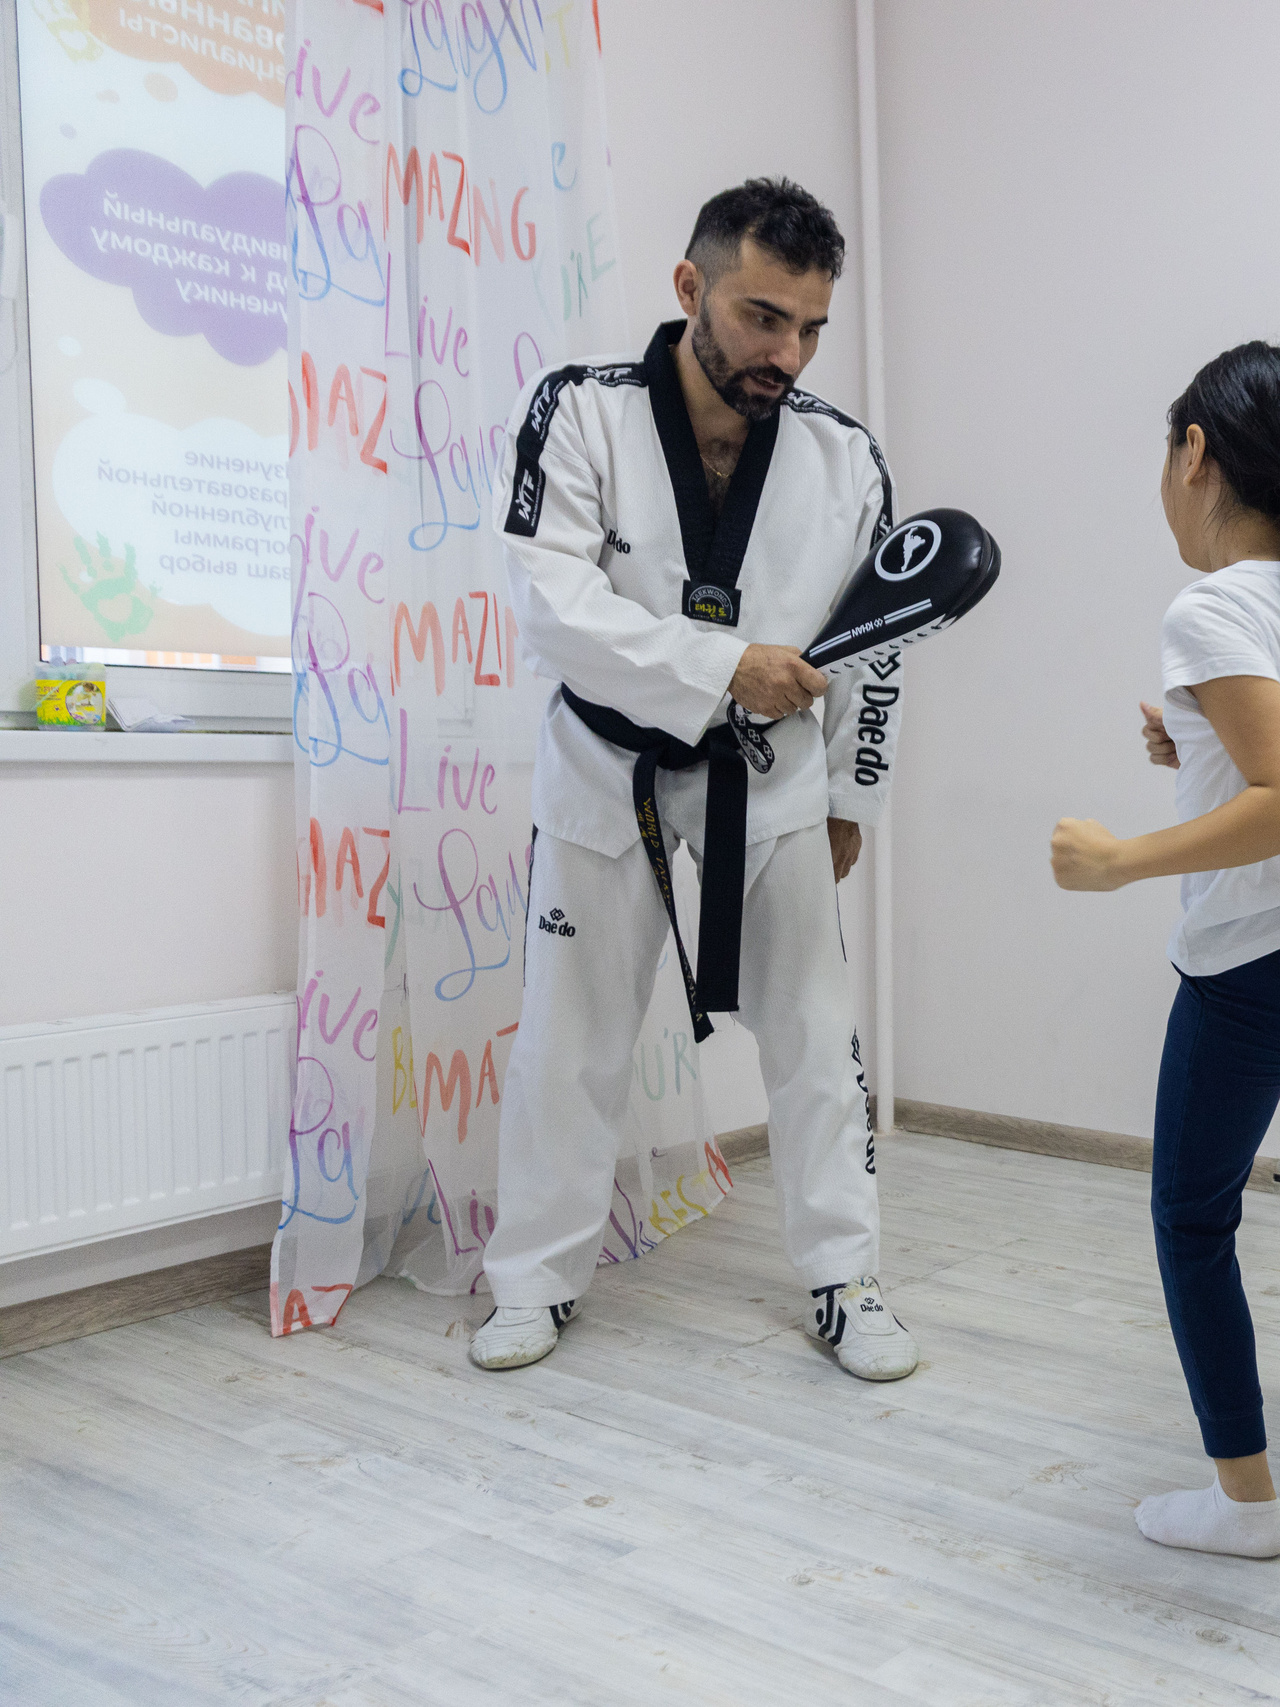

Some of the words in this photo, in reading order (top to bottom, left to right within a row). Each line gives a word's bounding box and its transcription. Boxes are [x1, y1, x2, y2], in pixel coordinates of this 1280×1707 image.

[516, 468, 535, 522] WTF
[851, 621, 874, 638] KHAN
[398, 708, 498, 815] Live
